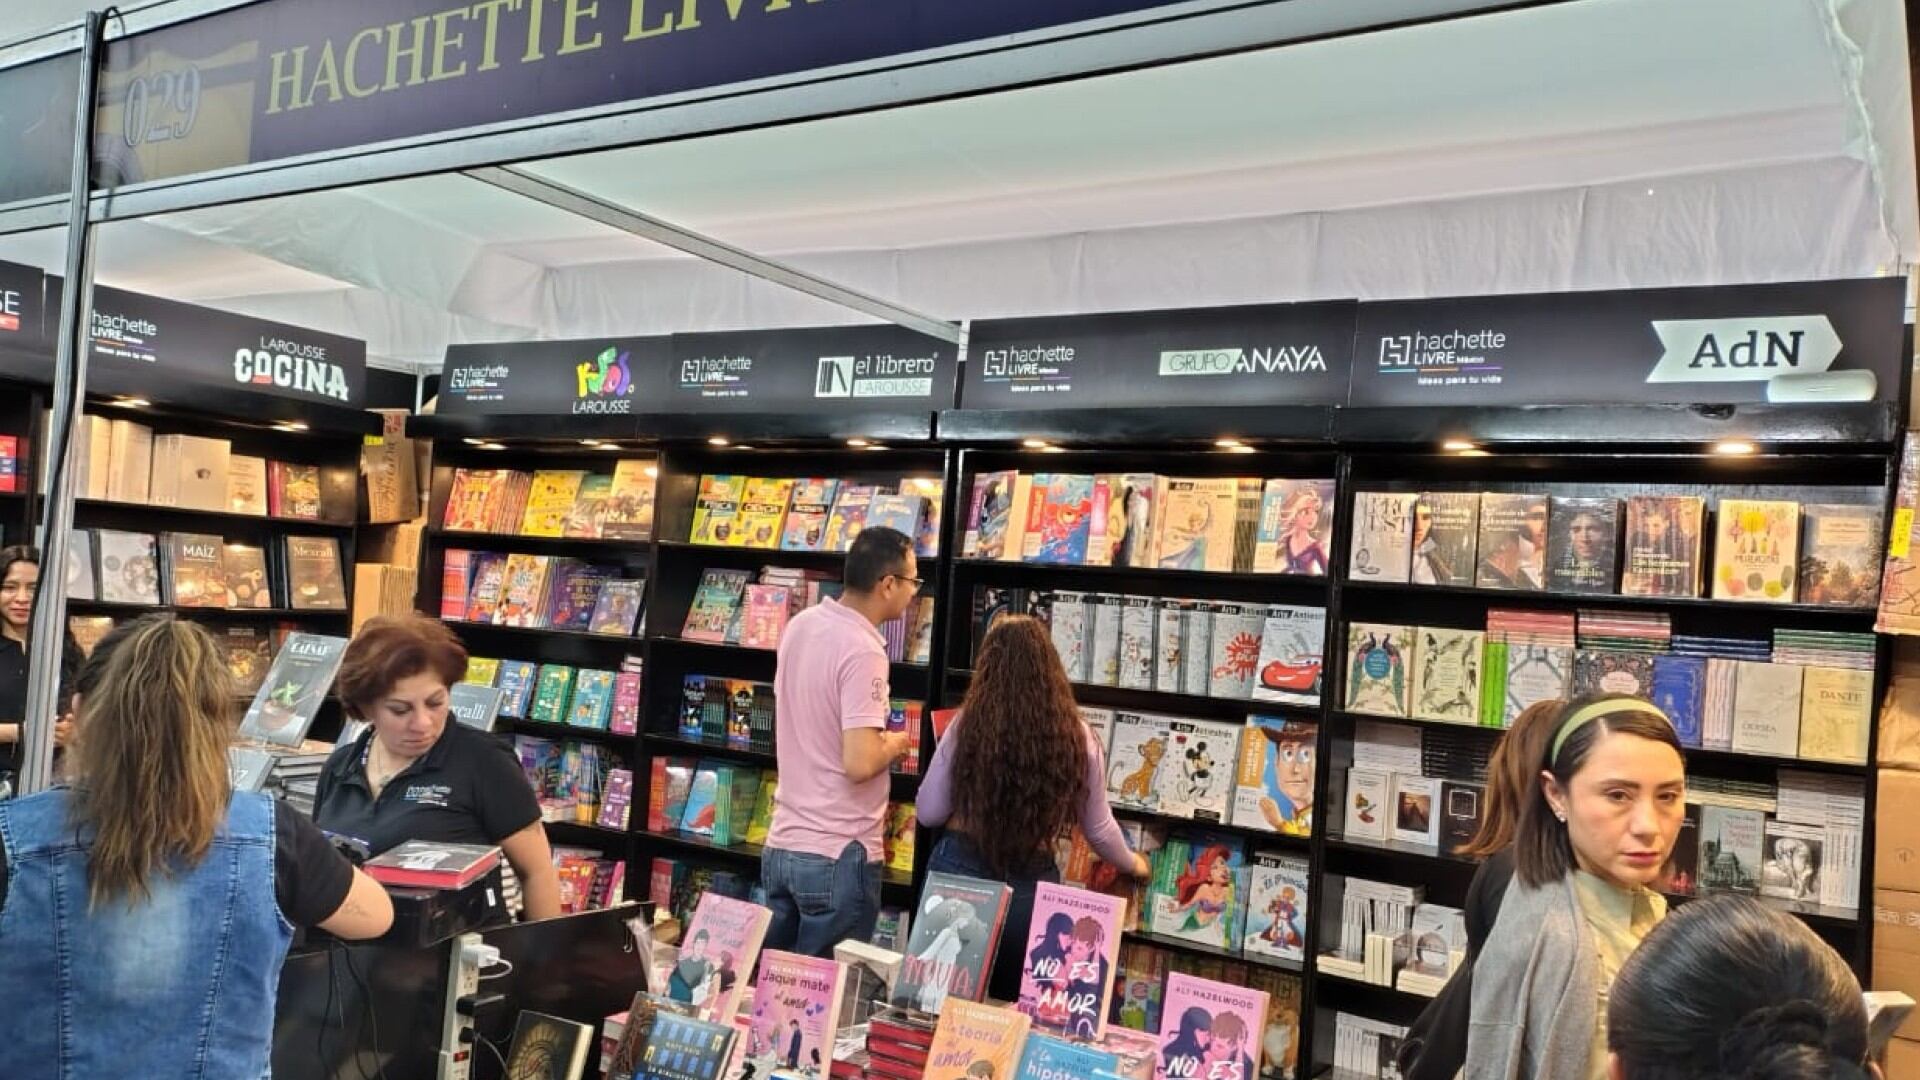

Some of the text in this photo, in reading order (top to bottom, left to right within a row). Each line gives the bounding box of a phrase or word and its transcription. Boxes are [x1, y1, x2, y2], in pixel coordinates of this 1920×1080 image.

[266, 0, 602, 114] HACHETTE
[123, 66, 199, 146] 029
[92, 309, 157, 336] hachette
[91, 326, 121, 341] LIVRE
[1415, 329, 1506, 350] hachette
[260, 335, 327, 361] LAROUSSE
[1009, 344, 1075, 363] hachette
[1168, 345, 1327, 372] GRUPO ANAYA
[1414, 351, 1456, 366] LIVRE
[1687, 330, 1805, 368] AdN
[468, 364, 509, 378] hachette
[701, 354, 752, 371] hachette
[855, 354, 935, 375] el librero
[1008, 363, 1038, 376] LIVRE
[233, 347, 349, 401] COCINA
[700, 371, 723, 382] LIVRE
[857, 380, 929, 395] LAROUSSE
[572, 400, 631, 414] LAROUSSE
[183, 543, 216, 559] MAÍZ
[1820, 690, 1862, 702] DANTE
[1033, 955, 1100, 984] NO ES
[762, 969, 831, 994] Jaque mate
[1037, 985, 1098, 1017] AMOR
[1192, 989, 1255, 1009] HAZELWOOD
[1166, 1053, 1244, 1080] NO ES
